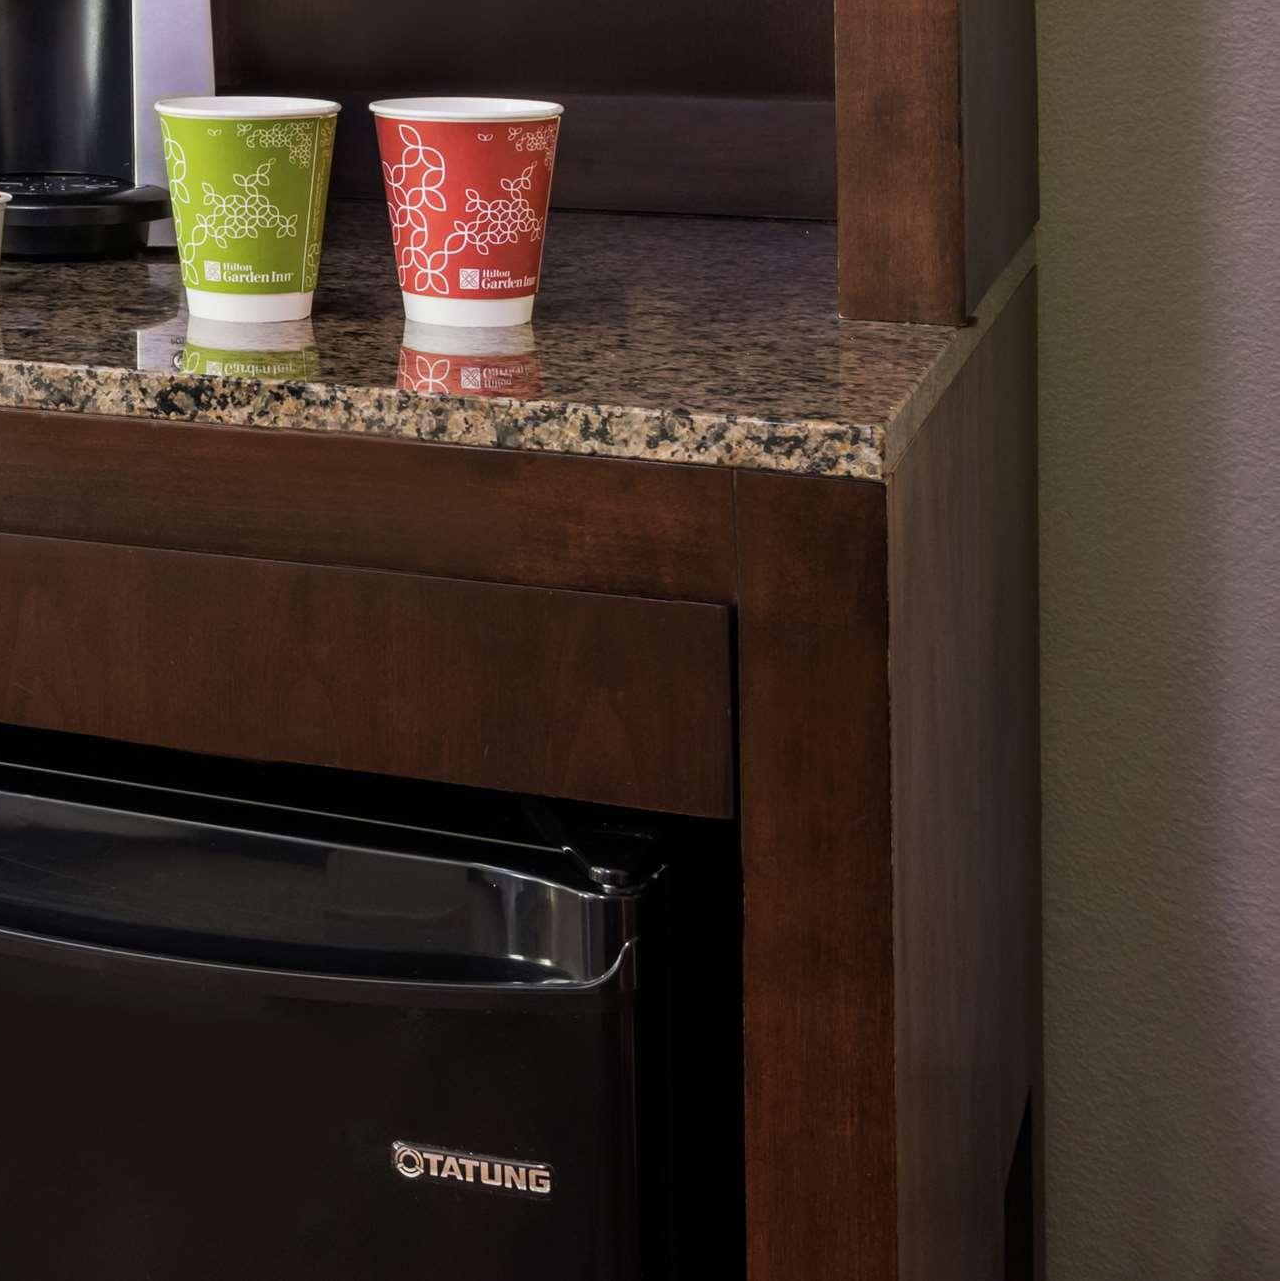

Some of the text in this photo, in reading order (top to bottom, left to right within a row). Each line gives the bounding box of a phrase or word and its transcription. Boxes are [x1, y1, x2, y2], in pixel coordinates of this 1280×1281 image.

[223, 262, 252, 271] Hilton
[222, 271, 291, 283] Garden Inn
[482, 269, 510, 278] Hilton
[481, 277, 522, 289] Garden
[422, 1152, 551, 1194] TATUNG
